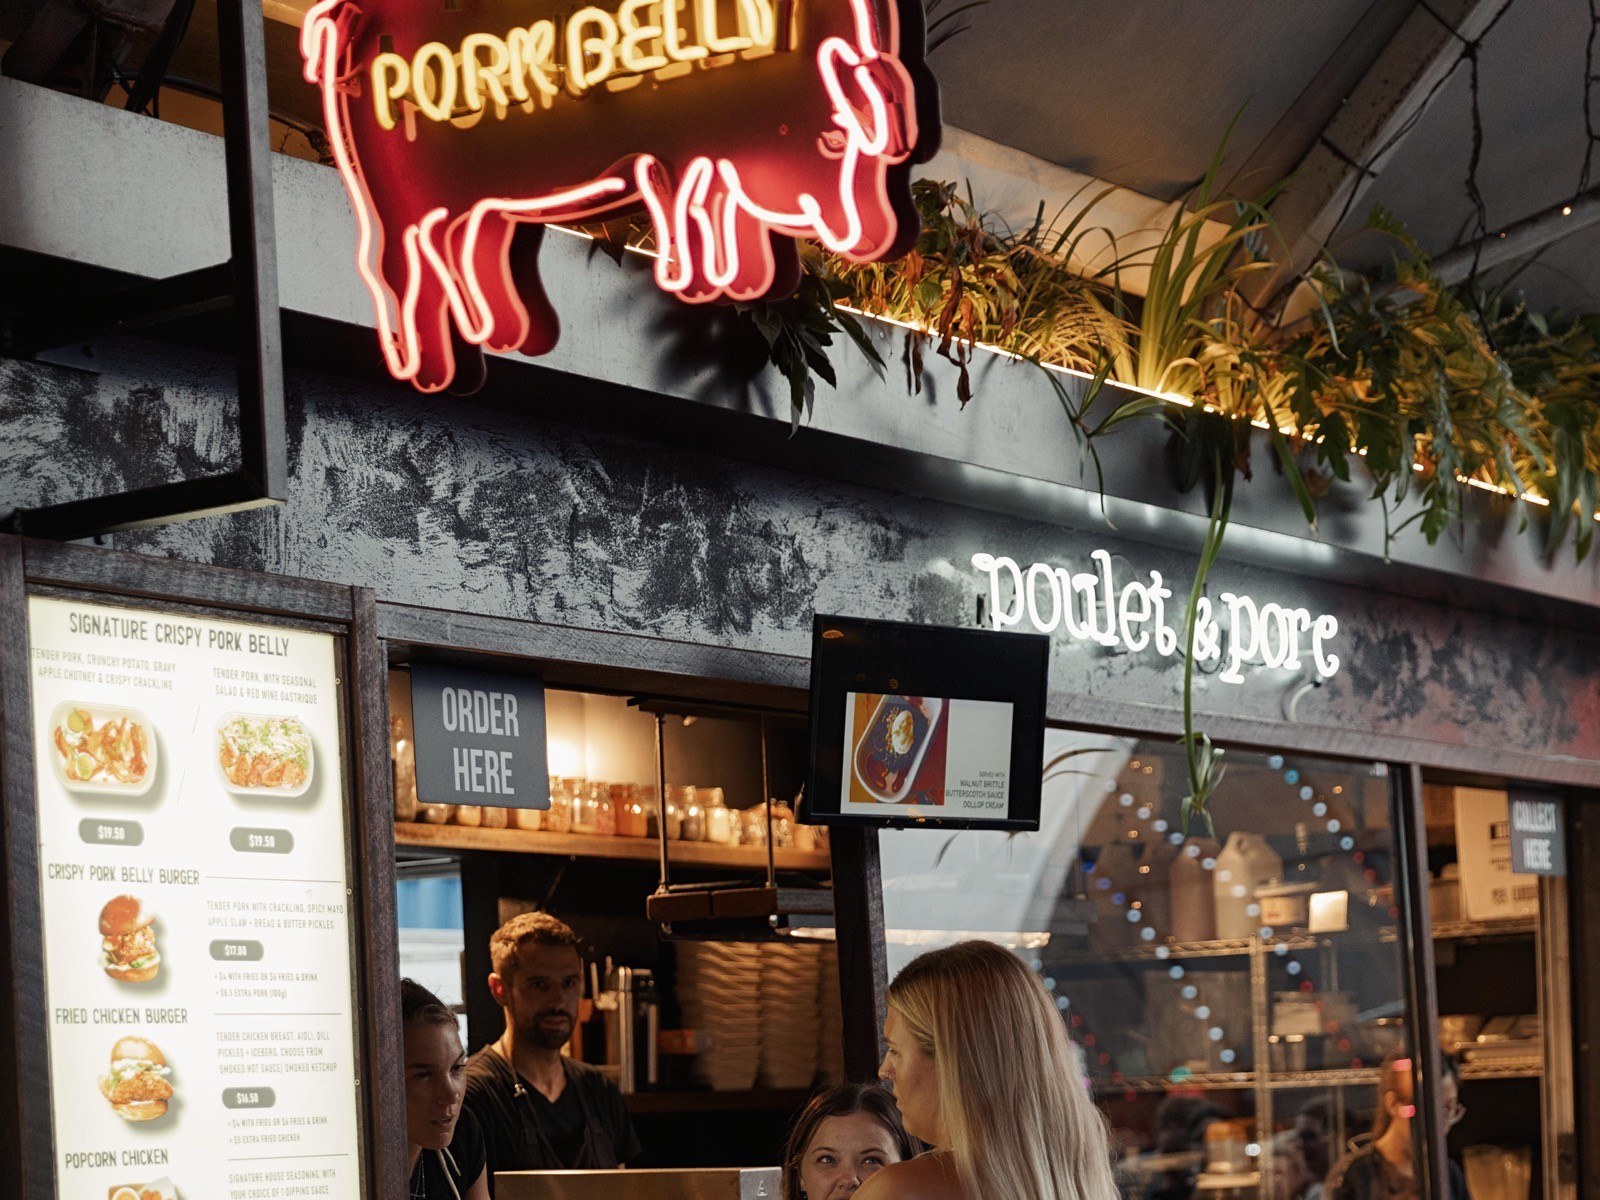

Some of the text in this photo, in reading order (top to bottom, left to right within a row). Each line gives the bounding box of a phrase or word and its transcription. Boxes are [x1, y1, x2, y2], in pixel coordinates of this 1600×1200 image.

[370, 19, 559, 130] PORK
[972, 549, 1176, 656] poulet
[1193, 597, 1219, 660] &
[69, 612, 289, 657] SIGNATURE CRISPY PORK BELLY
[31, 648, 60, 660] TENDER
[87, 653, 120, 667] CRUNCHY
[153, 661, 176, 673] GRAVY
[38, 666, 62, 679] APPLE
[64, 669, 96, 682] CHUTNEY
[106, 673, 131, 686] CRISPY
[134, 676, 172, 690] CRACKLING
[213, 668, 238, 680] TENDER
[263, 673, 280, 684] WITH
[282, 675, 317, 688] SEASONAL
[215, 685, 237, 697] SALAD
[247, 688, 260, 699] RED
[261, 690, 278, 700] WINE
[280, 691, 317, 704] GASTRIQUE
[442, 687, 519, 736] ORDER
[453, 748, 514, 794] HERE
[98, 824, 125, 841] $19.50
[248, 833, 275, 848] $19.50
[48, 863, 200, 885] CRISPY PORK BELLY BURGER
[207, 901, 231, 911] TENDER
[233, 901, 250, 911] PORK
[252, 902, 267, 911] WITH
[308, 904, 325, 913] SPICY
[327, 904, 343, 914] MAYO
[208, 918, 334, 929] APPLE SLAW BREAD BUTTER PICKLES
[225, 945, 247, 956] $17.00
[229, 972, 318, 981] WITH FRIES FRIES DRINK
[234, 989, 251, 997] EXTRA
[253, 989, 268, 997] PORK
[55, 1008, 188, 1024] FRIED CHICKEN BURGER
[216, 1032, 240, 1041] TENDER
[242, 1032, 268, 1041] CHICKEN
[317, 1031, 330, 1041] DILL
[218, 1047, 323, 1058] PICKLES CHOOSE FROM
[219, 1063, 337, 1074] SMOKED HOT SMOKED KETCHUP
[237, 1093, 258, 1104] $16.50
[242, 1116, 328, 1127] WITH FRIES FRIES DRINK
[243, 1133, 300, 1143] EXTRA FRIED CHICKEN
[65, 1148, 168, 1168] POPCORN CHICKEN
[229, 1173, 263, 1184] SIGNATURE
[265, 1171, 284, 1181] HOUSE
[322, 1169, 336, 1178] WITH
[230, 1185, 329, 1200] YOUR CHOICE OF DIPPING SAUCE
